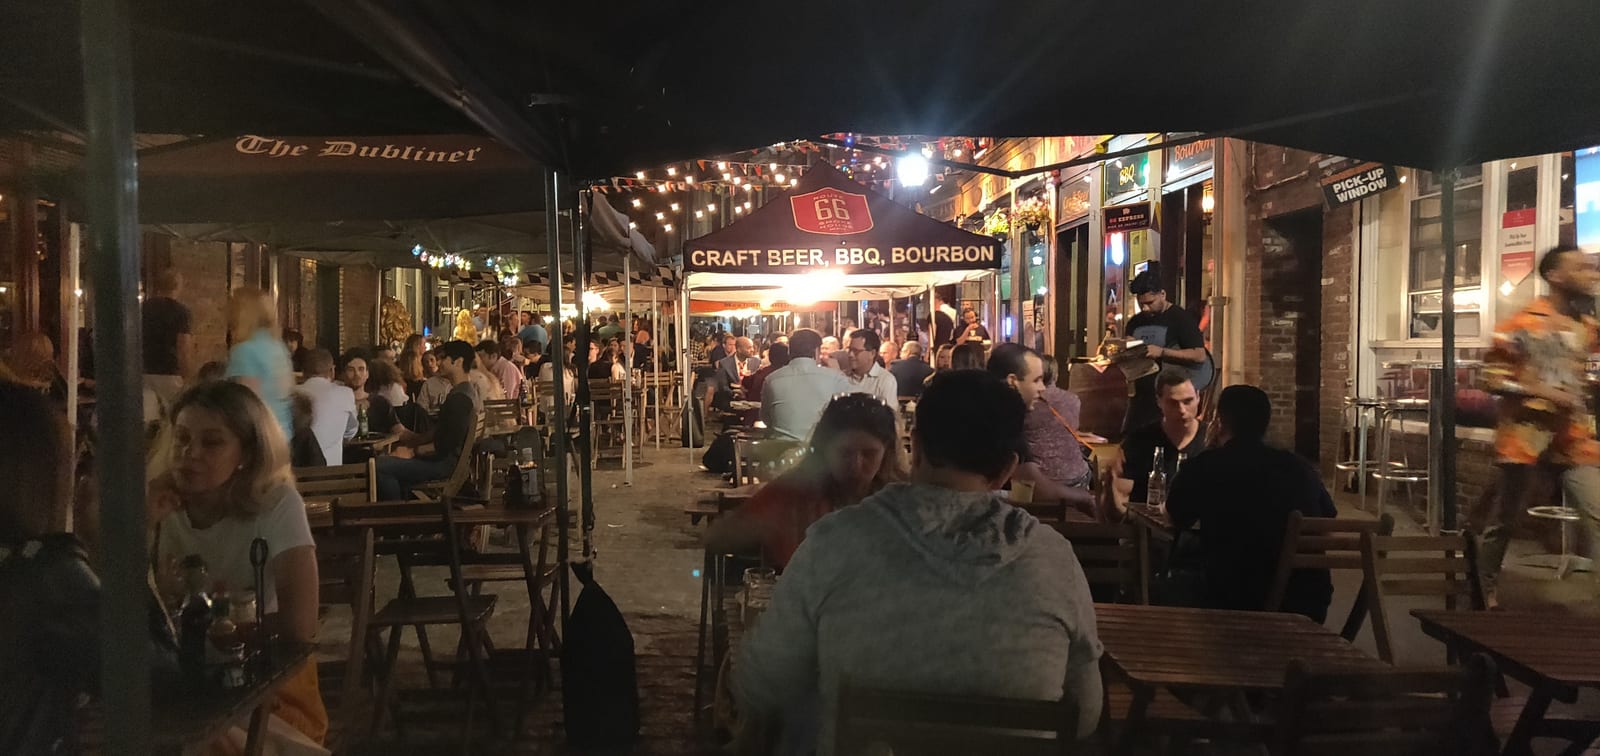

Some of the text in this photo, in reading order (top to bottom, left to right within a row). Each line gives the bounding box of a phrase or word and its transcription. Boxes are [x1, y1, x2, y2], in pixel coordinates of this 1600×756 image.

[235, 134, 482, 163] The Dubliner
[1119, 164, 1136, 186] BBQ
[1332, 168, 1385, 193] PICK-UP
[1336, 177, 1387, 203] WINDOW
[814, 198, 850, 220] 66
[691, 245, 994, 268] CRAFT BEER, BBQ, BOURBON
